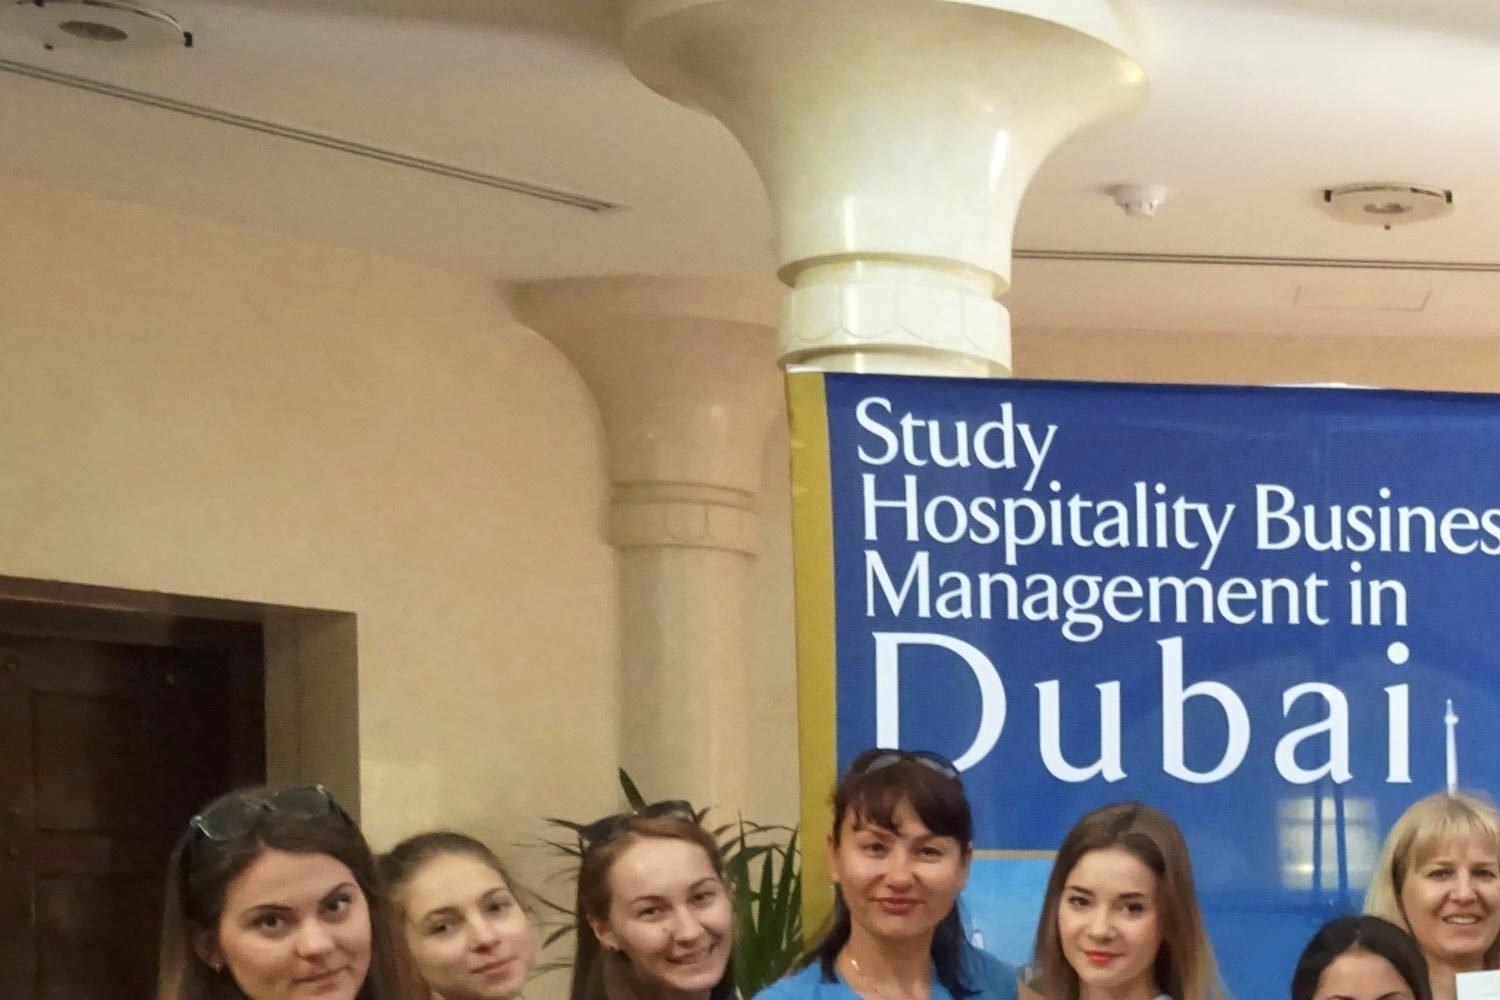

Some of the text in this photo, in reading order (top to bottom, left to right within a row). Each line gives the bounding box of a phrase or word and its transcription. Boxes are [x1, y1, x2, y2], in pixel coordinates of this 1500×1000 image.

[855, 397, 1058, 491] Study
[862, 472, 1236, 570] Hospitality
[864, 550, 1408, 641] Management in
[872, 632, 1413, 784] Dubai
